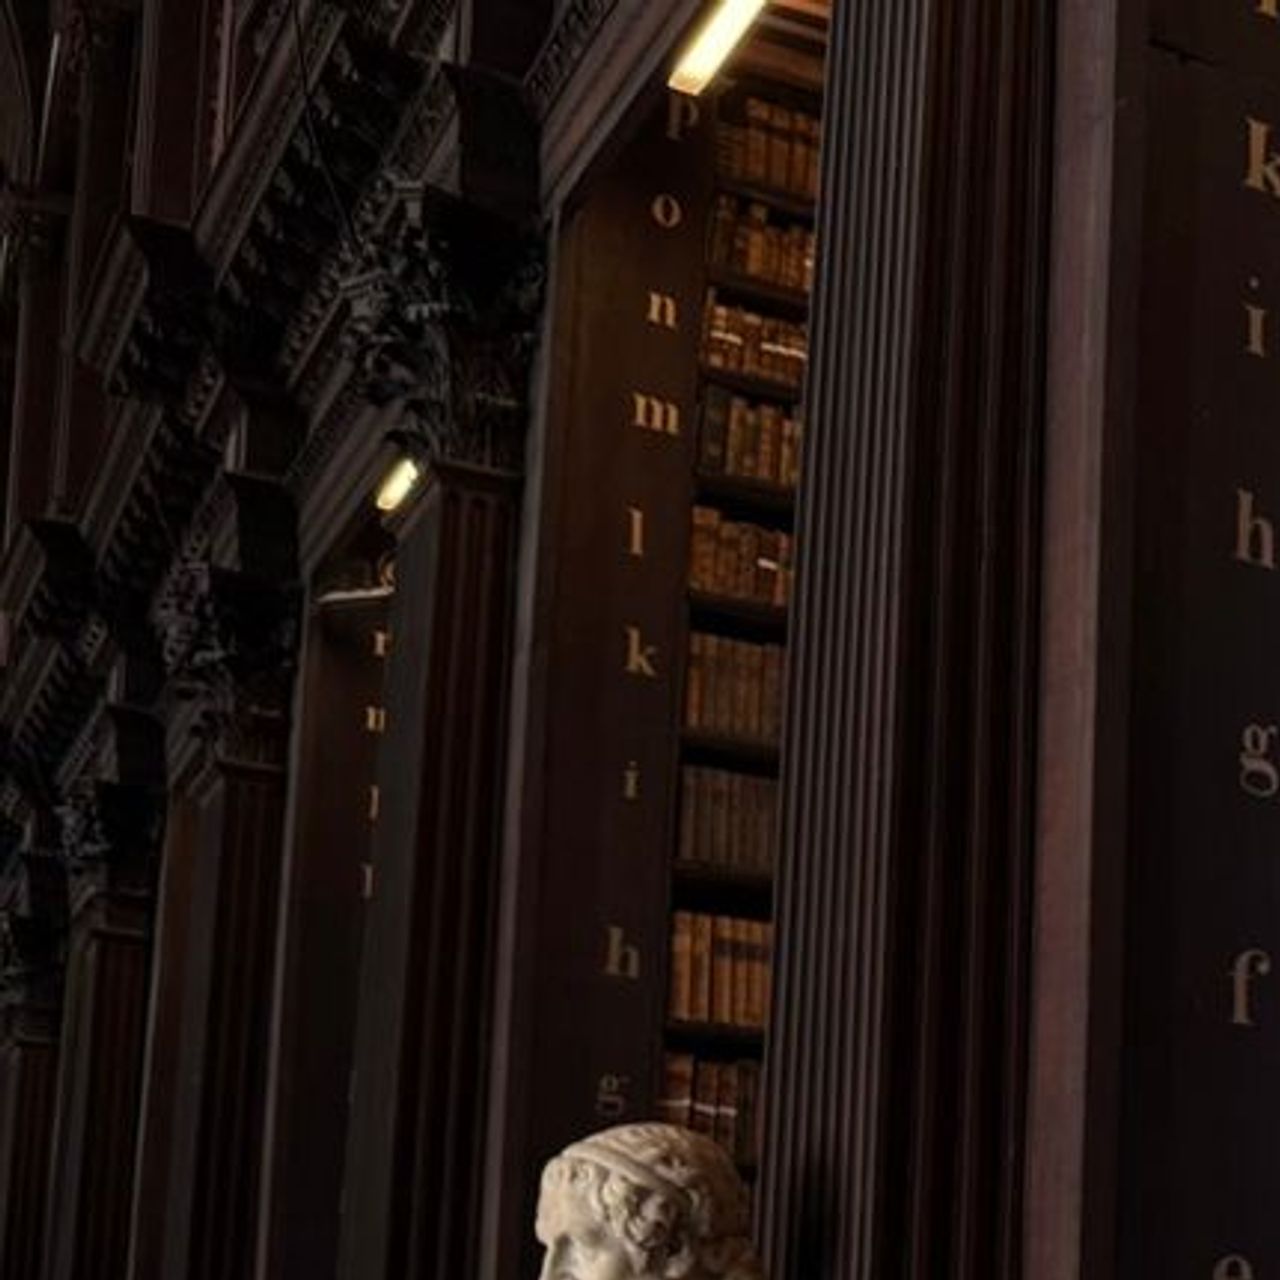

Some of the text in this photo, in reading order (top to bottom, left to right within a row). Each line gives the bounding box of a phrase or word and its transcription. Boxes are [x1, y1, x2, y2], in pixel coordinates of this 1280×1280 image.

[651, 193, 683, 228] o
[647, 291, 677, 329] n
[1241, 276, 1266, 357] i
[633, 392, 680, 436] m
[628, 507, 645, 556] l
[1234, 487, 1275, 569] h
[625, 626, 657, 678] k
[624, 760, 640, 800] i
[1239, 723, 1280, 798] g
[605, 925, 640, 979] h
[1229, 948, 1272, 1026] f
